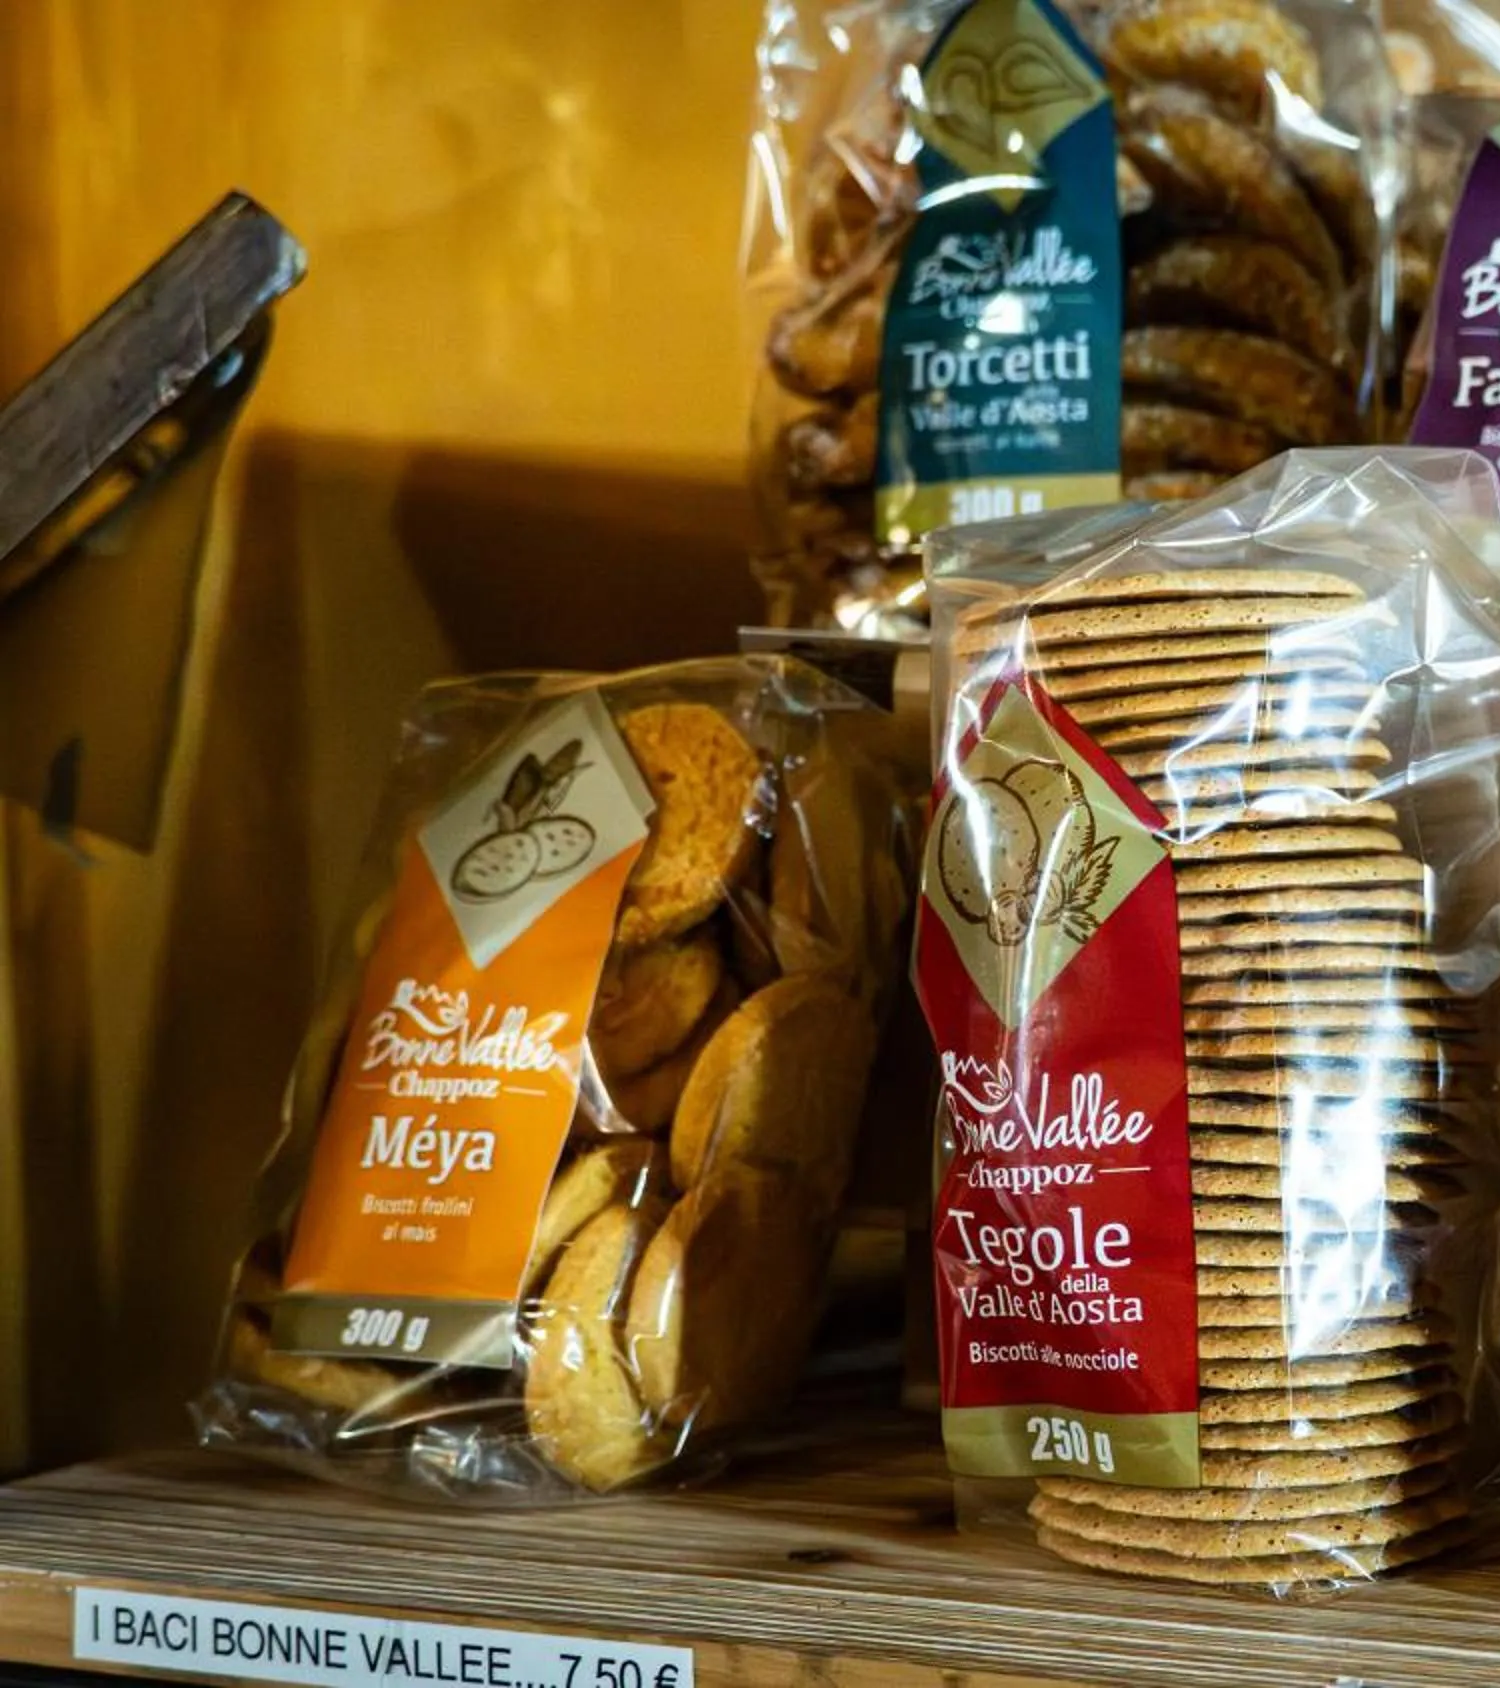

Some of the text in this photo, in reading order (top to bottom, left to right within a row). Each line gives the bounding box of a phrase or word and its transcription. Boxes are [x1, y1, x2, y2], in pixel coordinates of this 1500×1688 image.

[903, 330, 1091, 390] Torcetti
[951, 486, 1014, 526] 300
[388, 1070, 501, 1102] Chappoz
[360, 1114, 496, 1184] Méya
[947, 1206, 1131, 1286] Tegole
[957, 1285, 1143, 1325] Valle d'Aosta
[1060, 1273, 1110, 1294] della
[341, 1308, 429, 1352] 300 g
[969, 1340, 1039, 1365] Biscotti
[1064, 1347, 1139, 1371] nocciole
[1027, 1416, 1115, 1473] 250 g
[92, 1604, 99, 1641] I
[114, 1606, 197, 1653] BACI
[213, 1617, 347, 1669] BONNE
